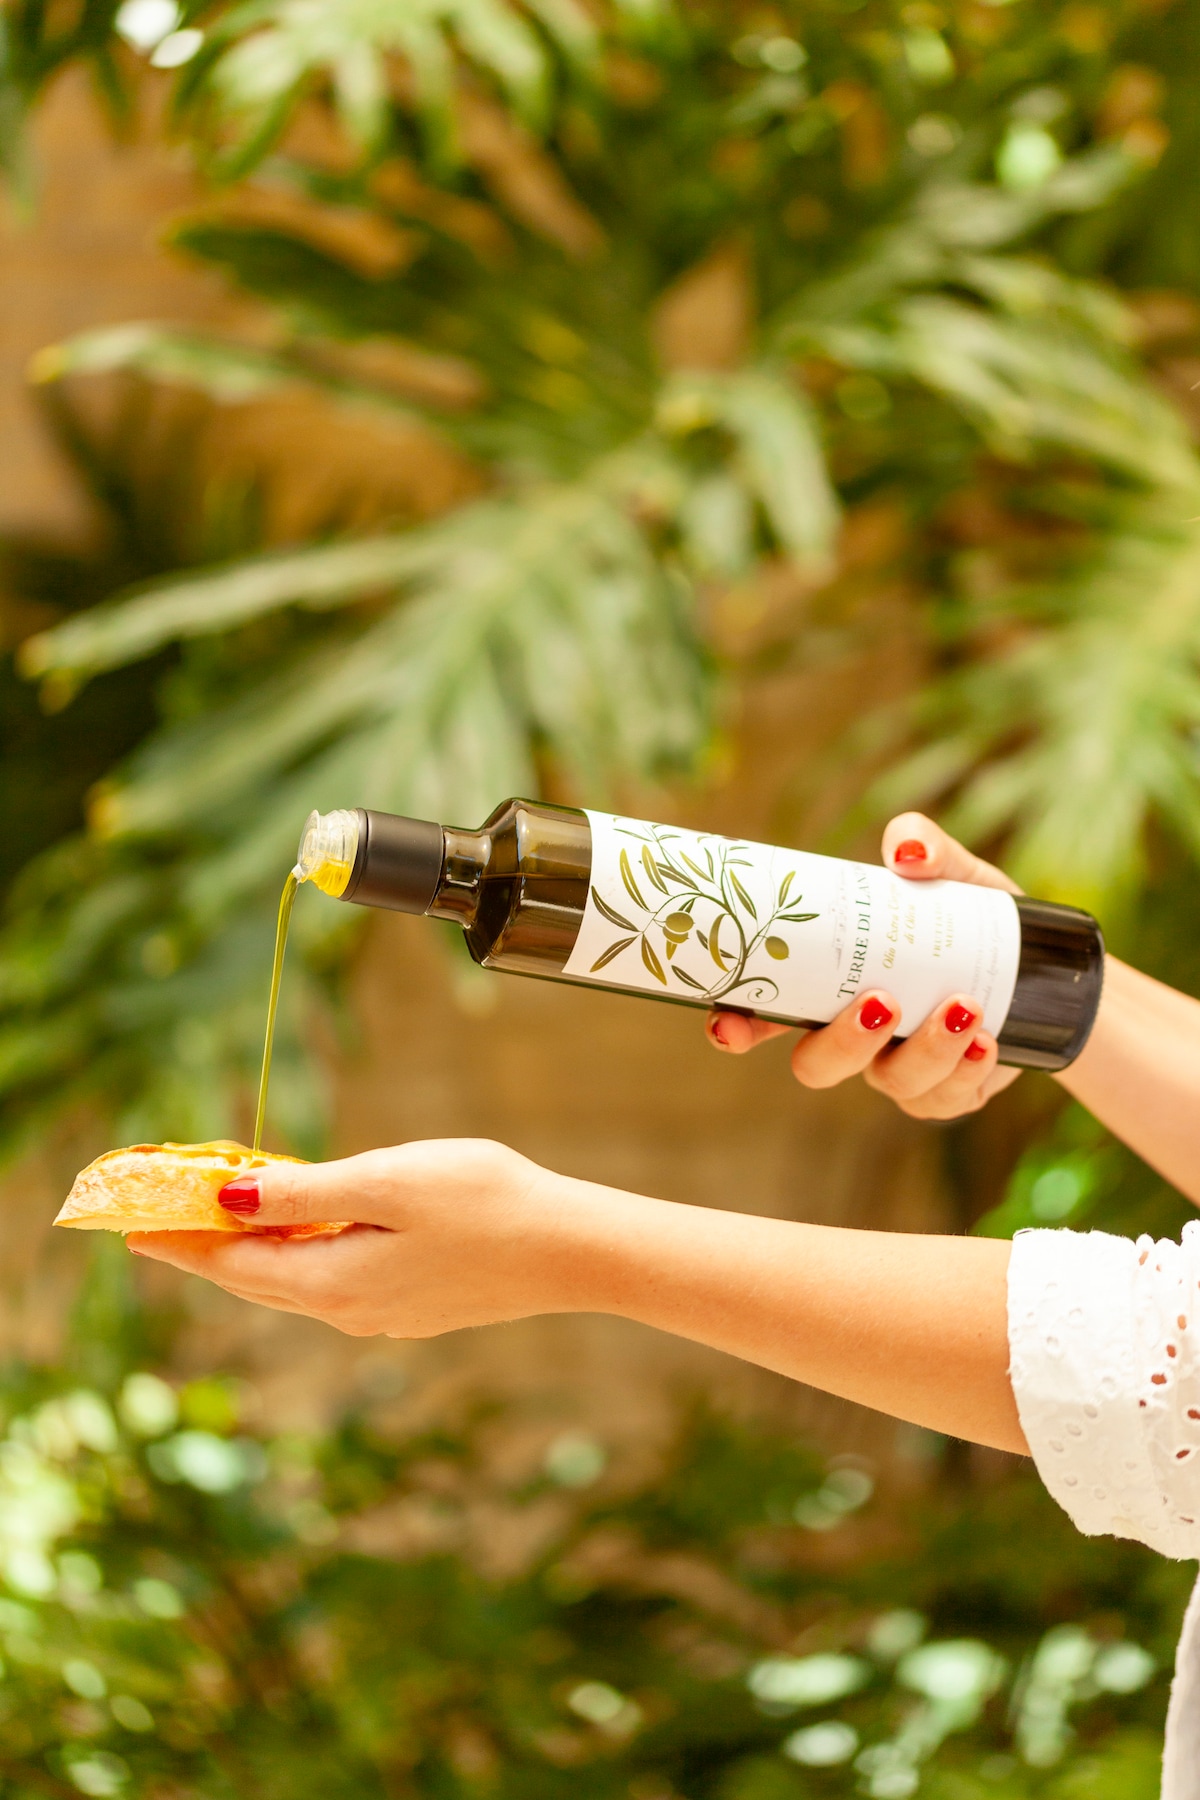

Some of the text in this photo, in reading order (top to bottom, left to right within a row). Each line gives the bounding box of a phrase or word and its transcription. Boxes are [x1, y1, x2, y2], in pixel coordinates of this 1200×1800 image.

[885, 914, 899, 943] Extra
[903, 933, 915, 945] di
[837, 936, 869, 998] TERRE
[882, 947, 896, 969] Olio
